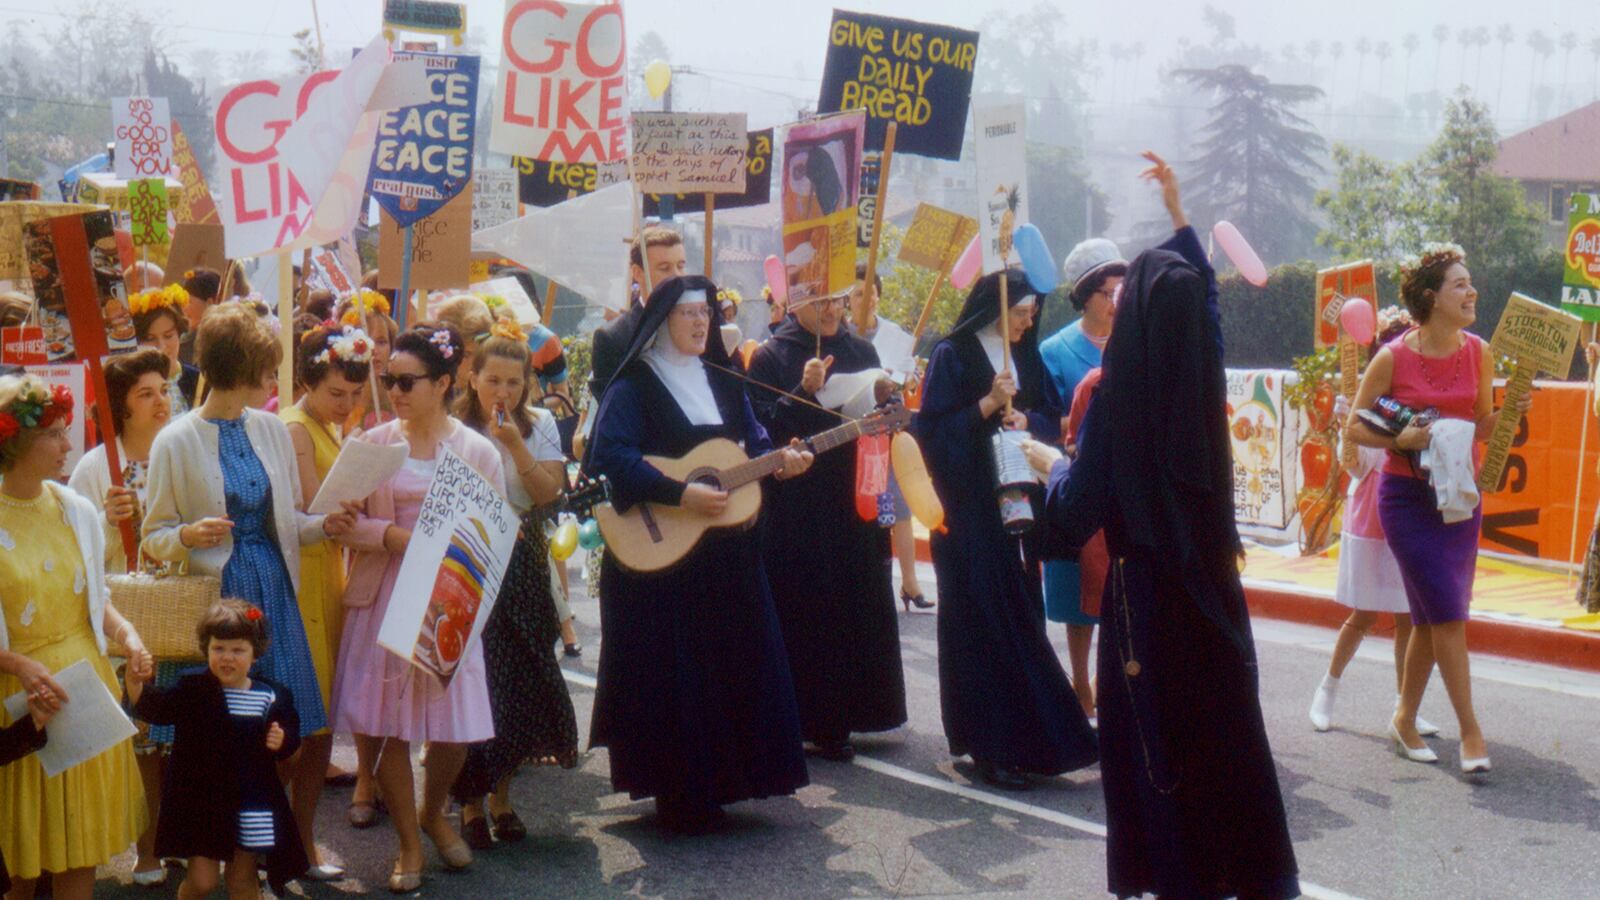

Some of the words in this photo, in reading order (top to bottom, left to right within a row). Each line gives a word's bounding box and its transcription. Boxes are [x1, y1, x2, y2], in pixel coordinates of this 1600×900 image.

[503, 0, 625, 78] GO
[503, 70, 624, 130] LIKE
[117, 125, 167, 143] GOOD
[379, 107, 470, 142] EACE
[132, 141, 162, 157] FOR
[376, 140, 469, 178] EACE
[536, 126, 627, 162] ME
[129, 157, 171, 175] YOU
[678, 169, 737, 184] Samuel
[1503, 314, 1568, 355] STOCKTON
